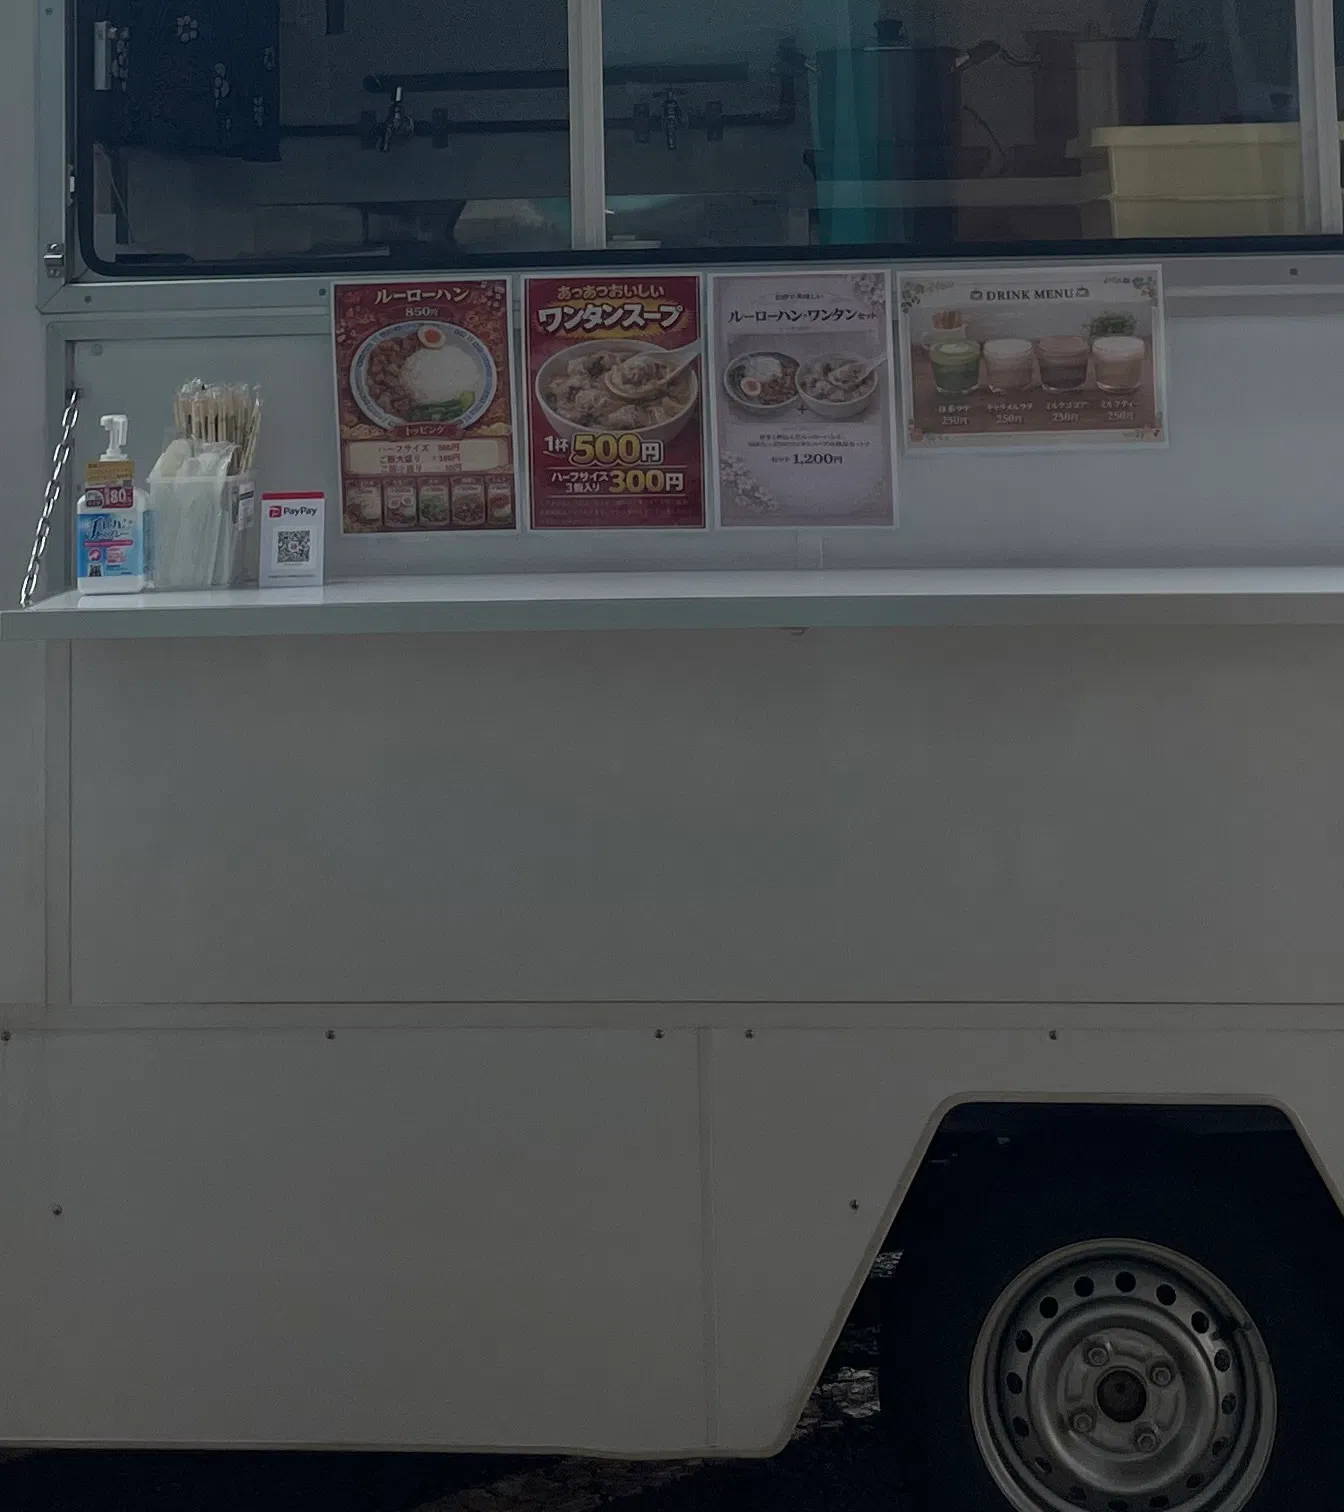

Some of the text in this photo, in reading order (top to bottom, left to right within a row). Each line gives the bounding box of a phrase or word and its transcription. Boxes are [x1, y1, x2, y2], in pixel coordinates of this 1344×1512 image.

[374, 287, 470, 305] ルーローハン
[986, 288, 1074, 301] DRINK MENU
[537, 303, 683, 332] ワンタンスープ
[570, 433, 661, 465] 500円
[793, 453, 843, 465] 1,200円
[551, 470, 683, 494] ハーフサイズ 300円
[283, 506, 317, 516] PayPay
